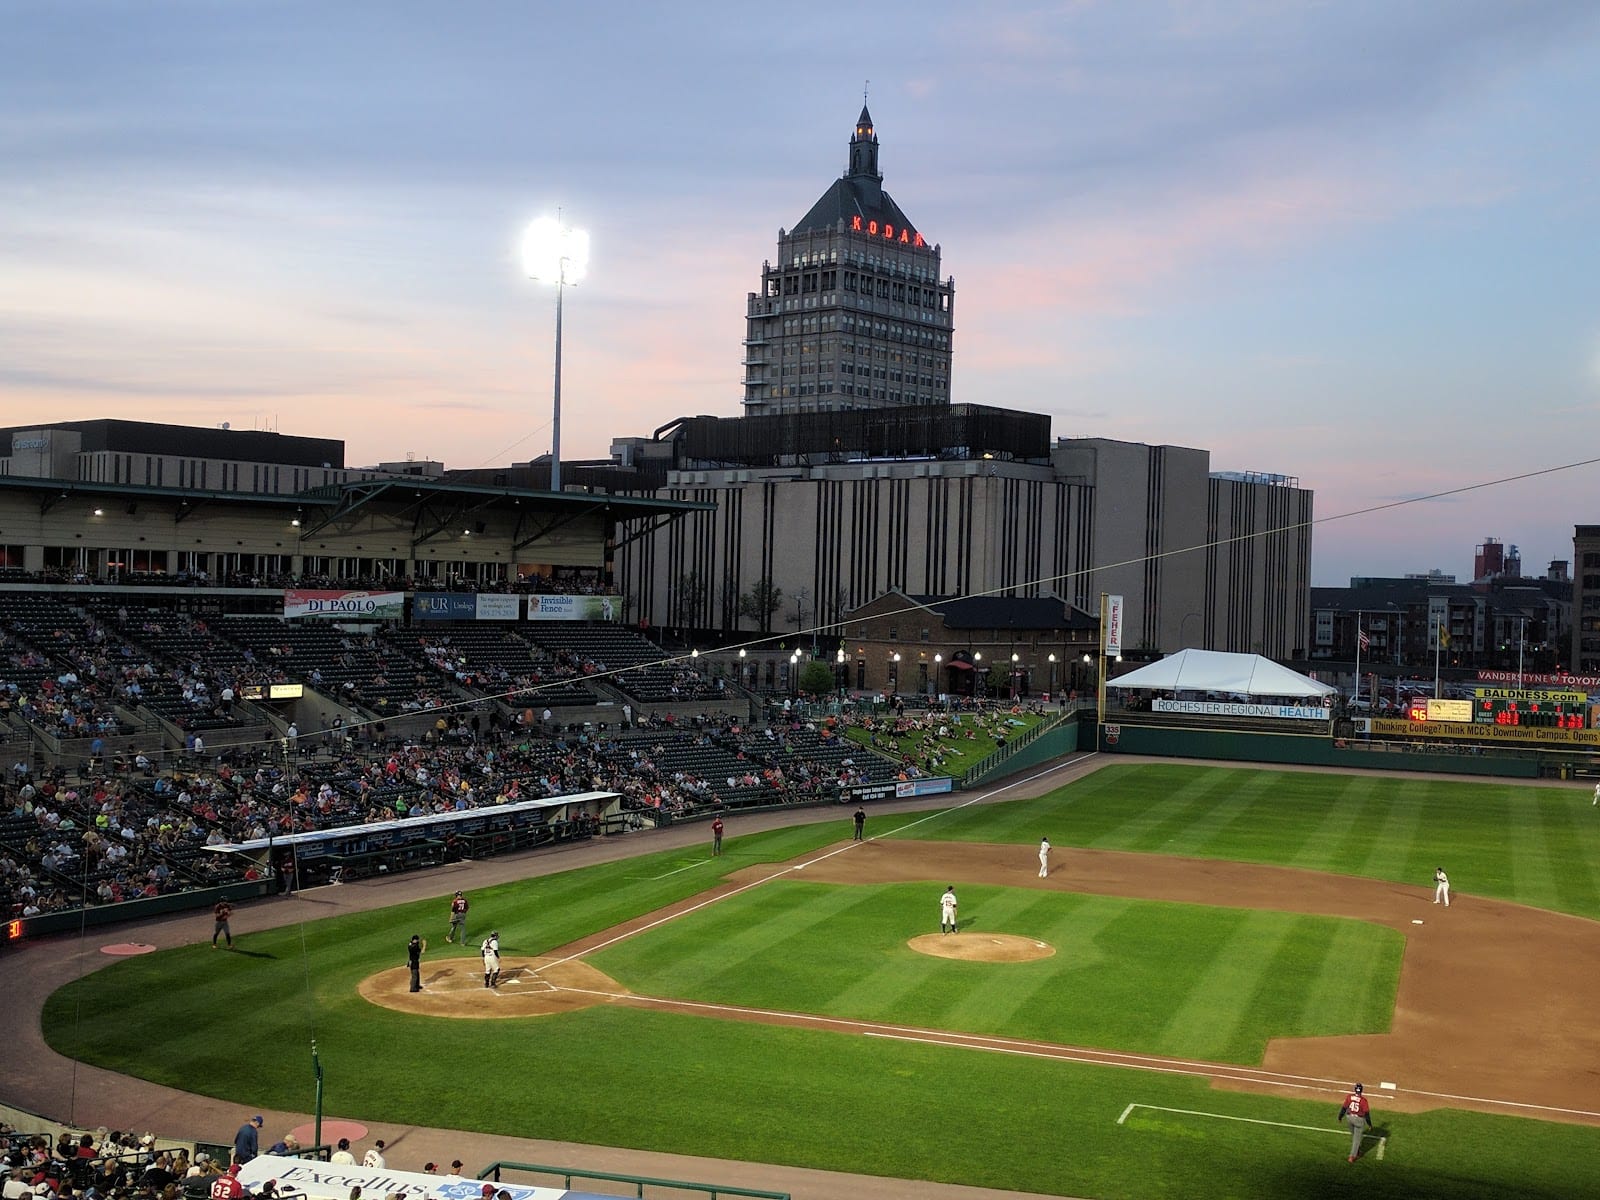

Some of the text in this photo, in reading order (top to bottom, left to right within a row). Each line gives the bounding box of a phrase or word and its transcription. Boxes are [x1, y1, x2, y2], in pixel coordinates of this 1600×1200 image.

[853, 216, 923, 247] KODAK
[309, 600, 323, 611] DI
[330, 600, 375, 611] PAOLO
[431, 597, 448, 610] UR
[541, 596, 573, 604] Invisible
[1111, 605, 1119, 645] FEHER
[1478, 671, 1548, 683] VANDERSTYNE
[1484, 689, 1578, 701] BALDNESS.com
[1158, 701, 1323, 718] ROCHESTER REGIONAL HEALTH
[1411, 709, 1427, 720] 96
[1375, 720, 1407, 733] Thinking
[1409, 723, 1441, 735] College?
[1444, 724, 1465, 735] Think
[1466, 725, 1491, 736] MCC's
[1493, 727, 1534, 738] Downtown
[1573, 730, 1598, 742] Opens
[432, 822, 456, 832] GEICO
[1349, 1101, 1360, 1113] 45
[280, 1166, 428, 1195] Excellus
[213, 1184, 231, 1199] 32
